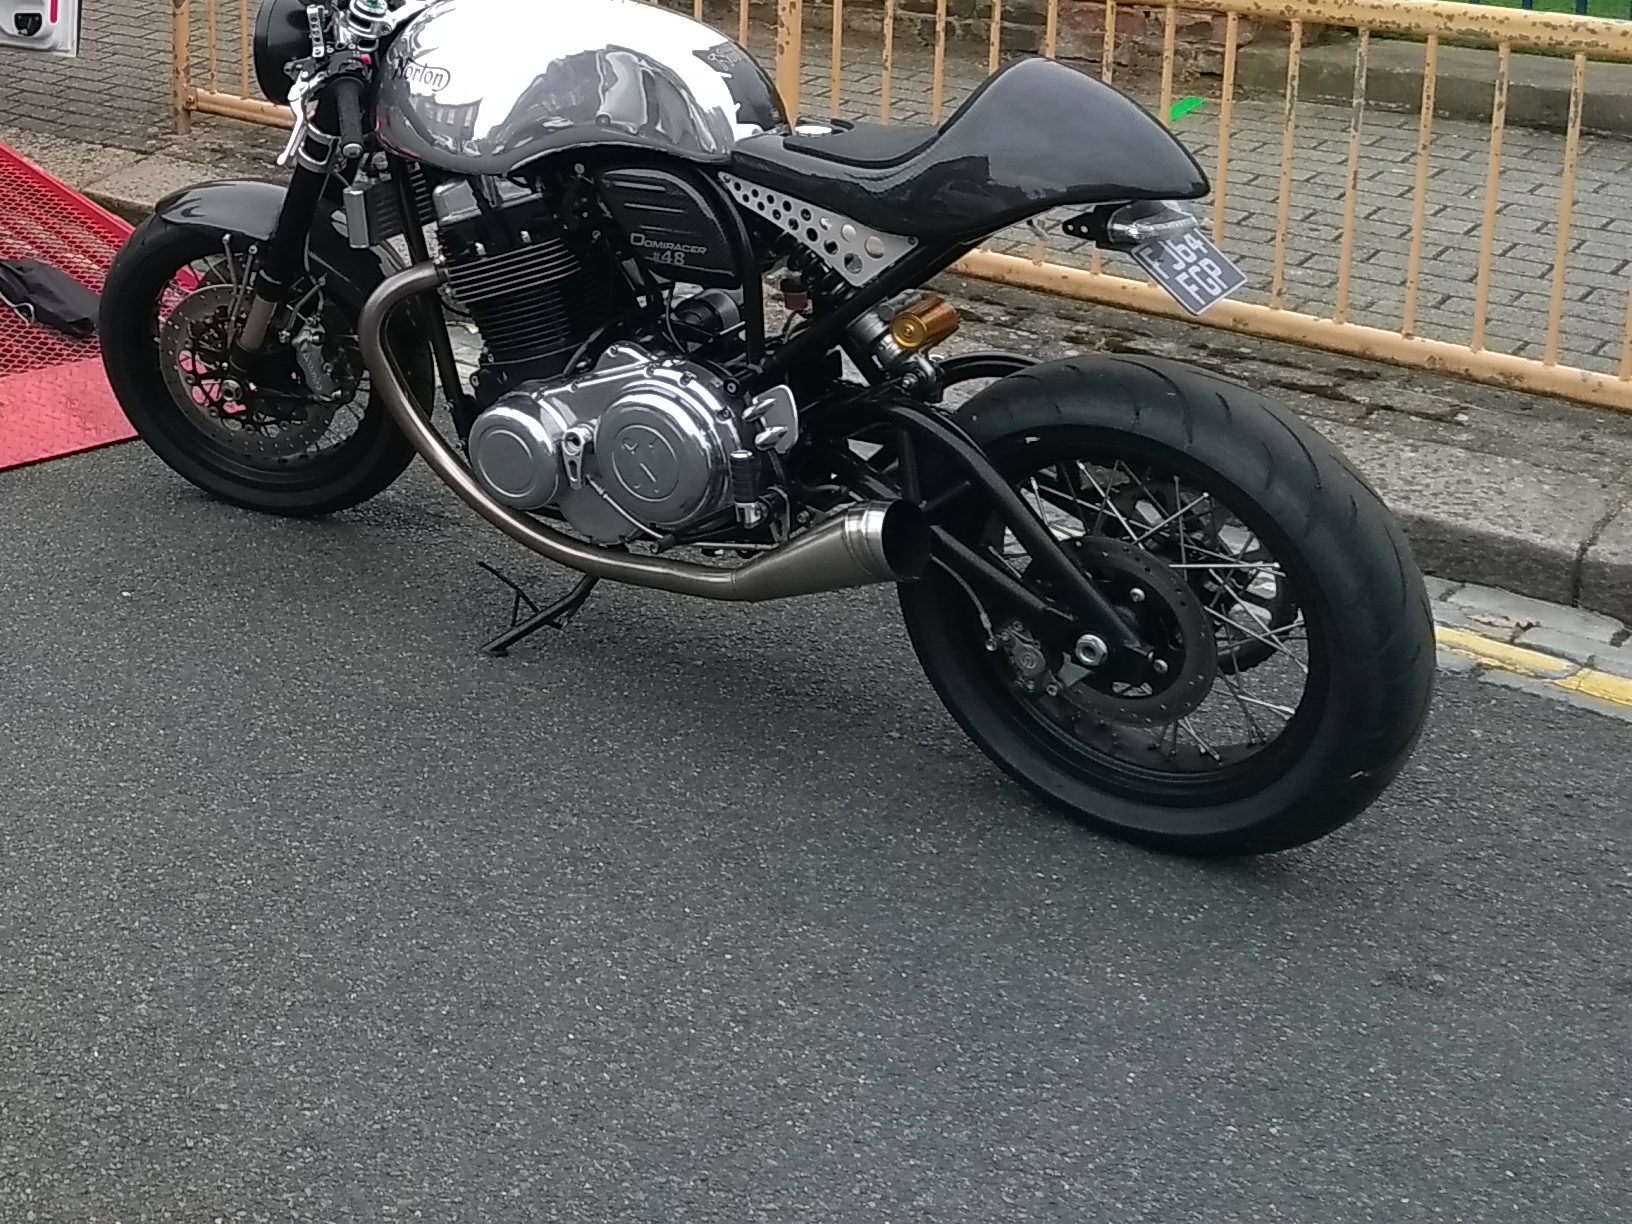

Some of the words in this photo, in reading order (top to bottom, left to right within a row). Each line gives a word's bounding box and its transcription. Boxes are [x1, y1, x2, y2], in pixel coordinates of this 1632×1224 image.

[392, 55, 451, 92] Norton
[653, 250, 686, 266] #48
[1175, 257, 1228, 306] FGP
